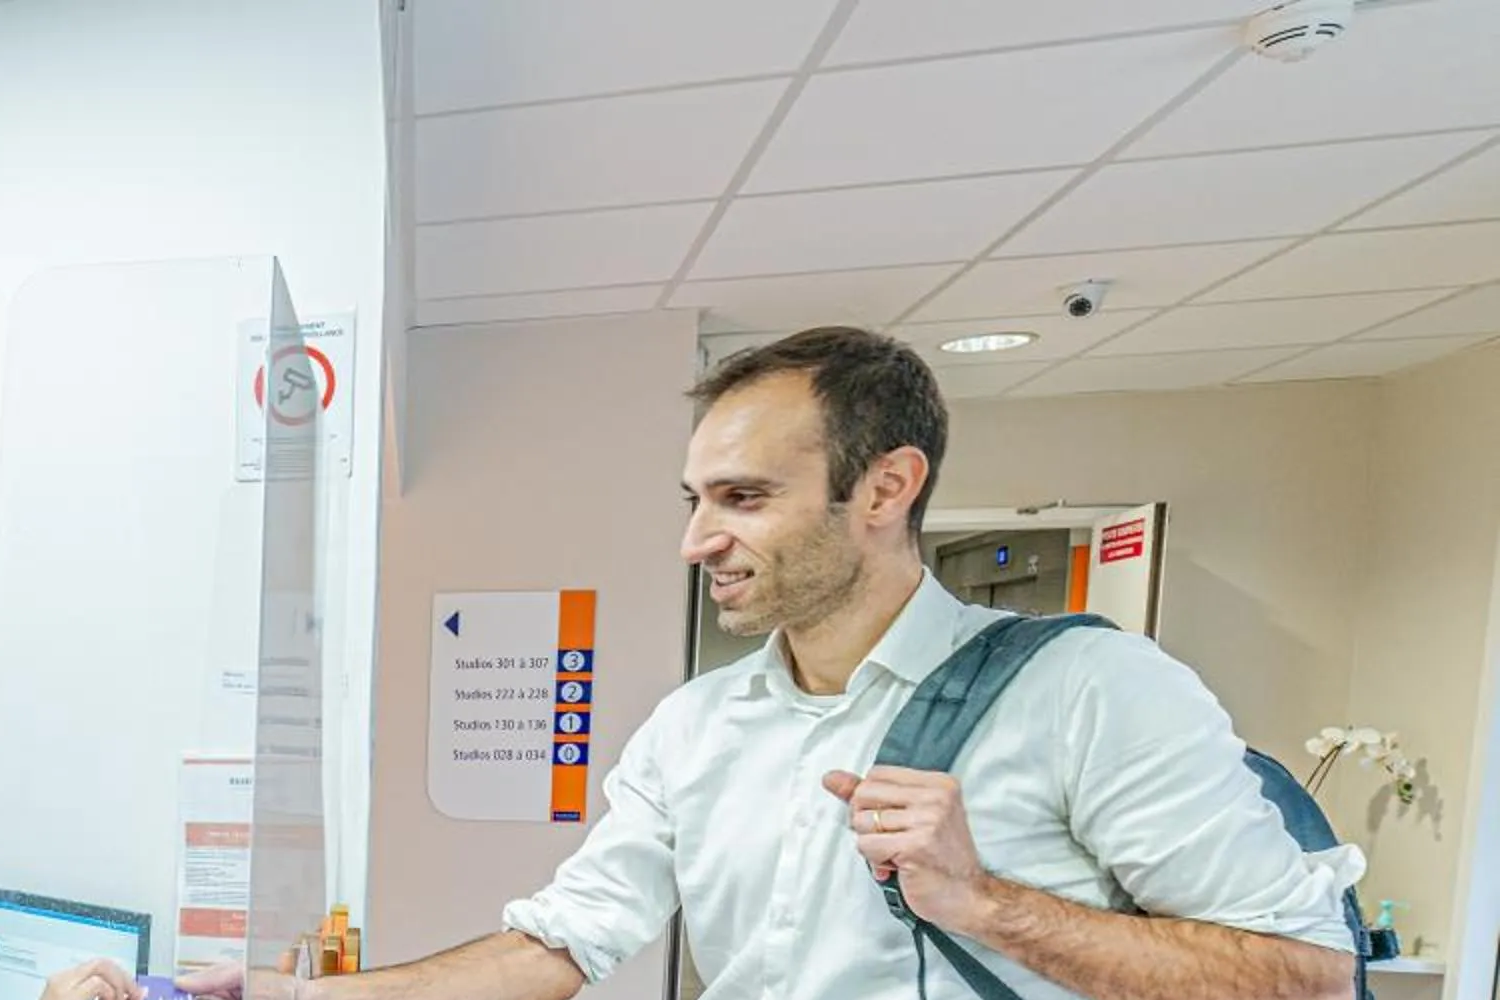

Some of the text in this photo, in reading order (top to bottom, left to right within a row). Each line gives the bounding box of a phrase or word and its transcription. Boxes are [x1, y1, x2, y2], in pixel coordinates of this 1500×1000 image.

[455, 657, 493, 670] Studios
[496, 657, 515, 669] 301
[529, 657, 549, 669] 307
[569, 653, 579, 669] 3
[455, 688, 493, 700] Studios
[495, 688, 515, 700] 222
[527, 687, 549, 700] 228
[567, 685, 577, 699] 2
[453, 719, 492, 731] Studios
[494, 719, 515, 731] 130
[567, 715, 574, 730] 1
[453, 748, 491, 761] Studios
[493, 748, 513, 761] 028
[525, 748, 546, 761] 034
[564, 746, 575, 762] 0
